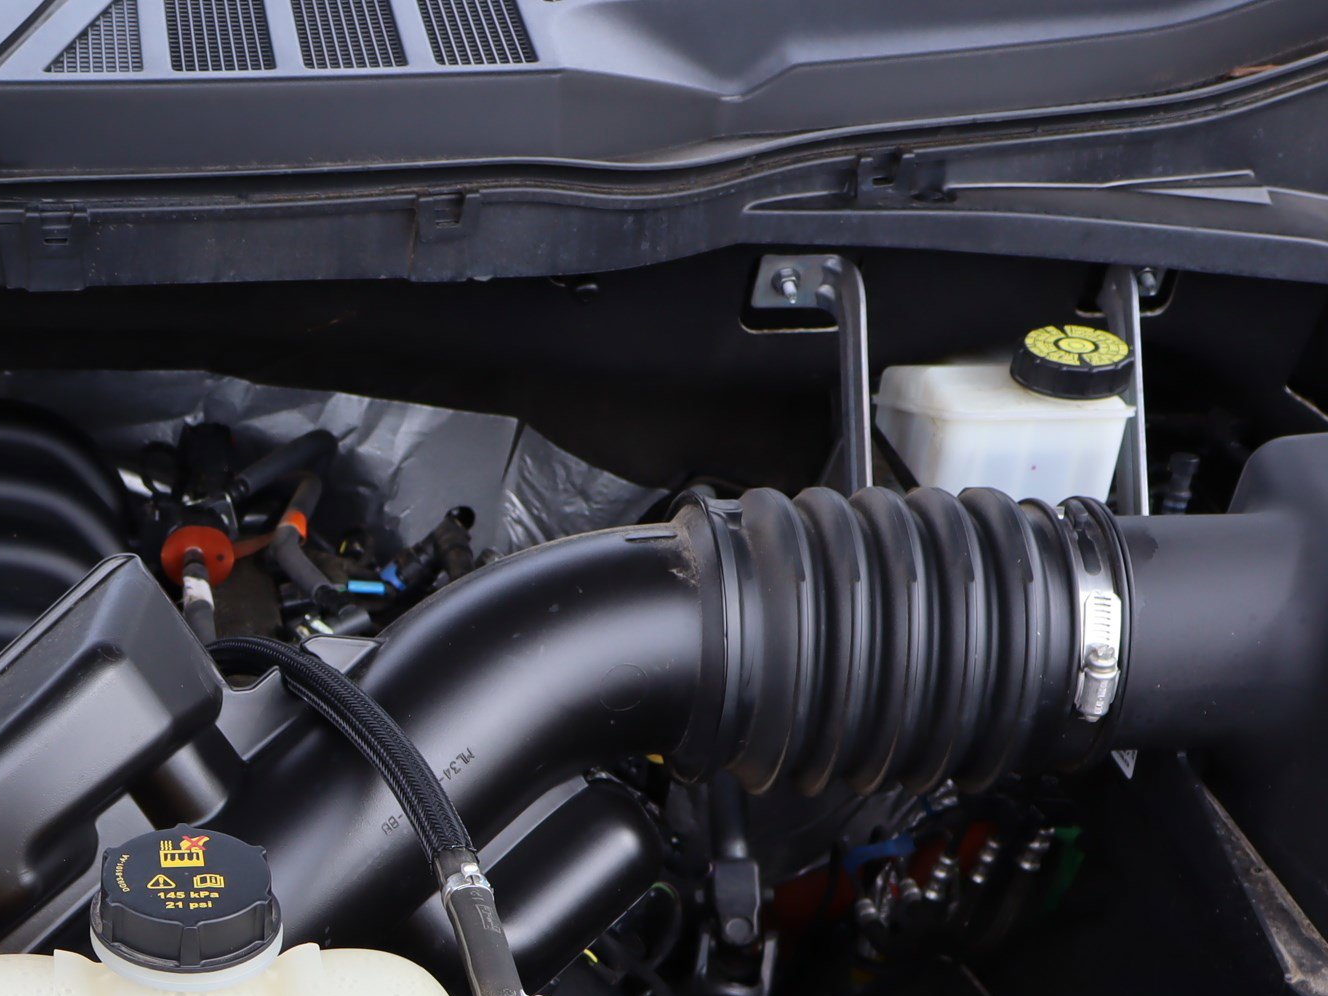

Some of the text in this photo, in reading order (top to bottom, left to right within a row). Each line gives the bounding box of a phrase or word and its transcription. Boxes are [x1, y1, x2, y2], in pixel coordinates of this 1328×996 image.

[157, 891, 186, 899] 145
[165, 901, 212, 910] 21 psi
